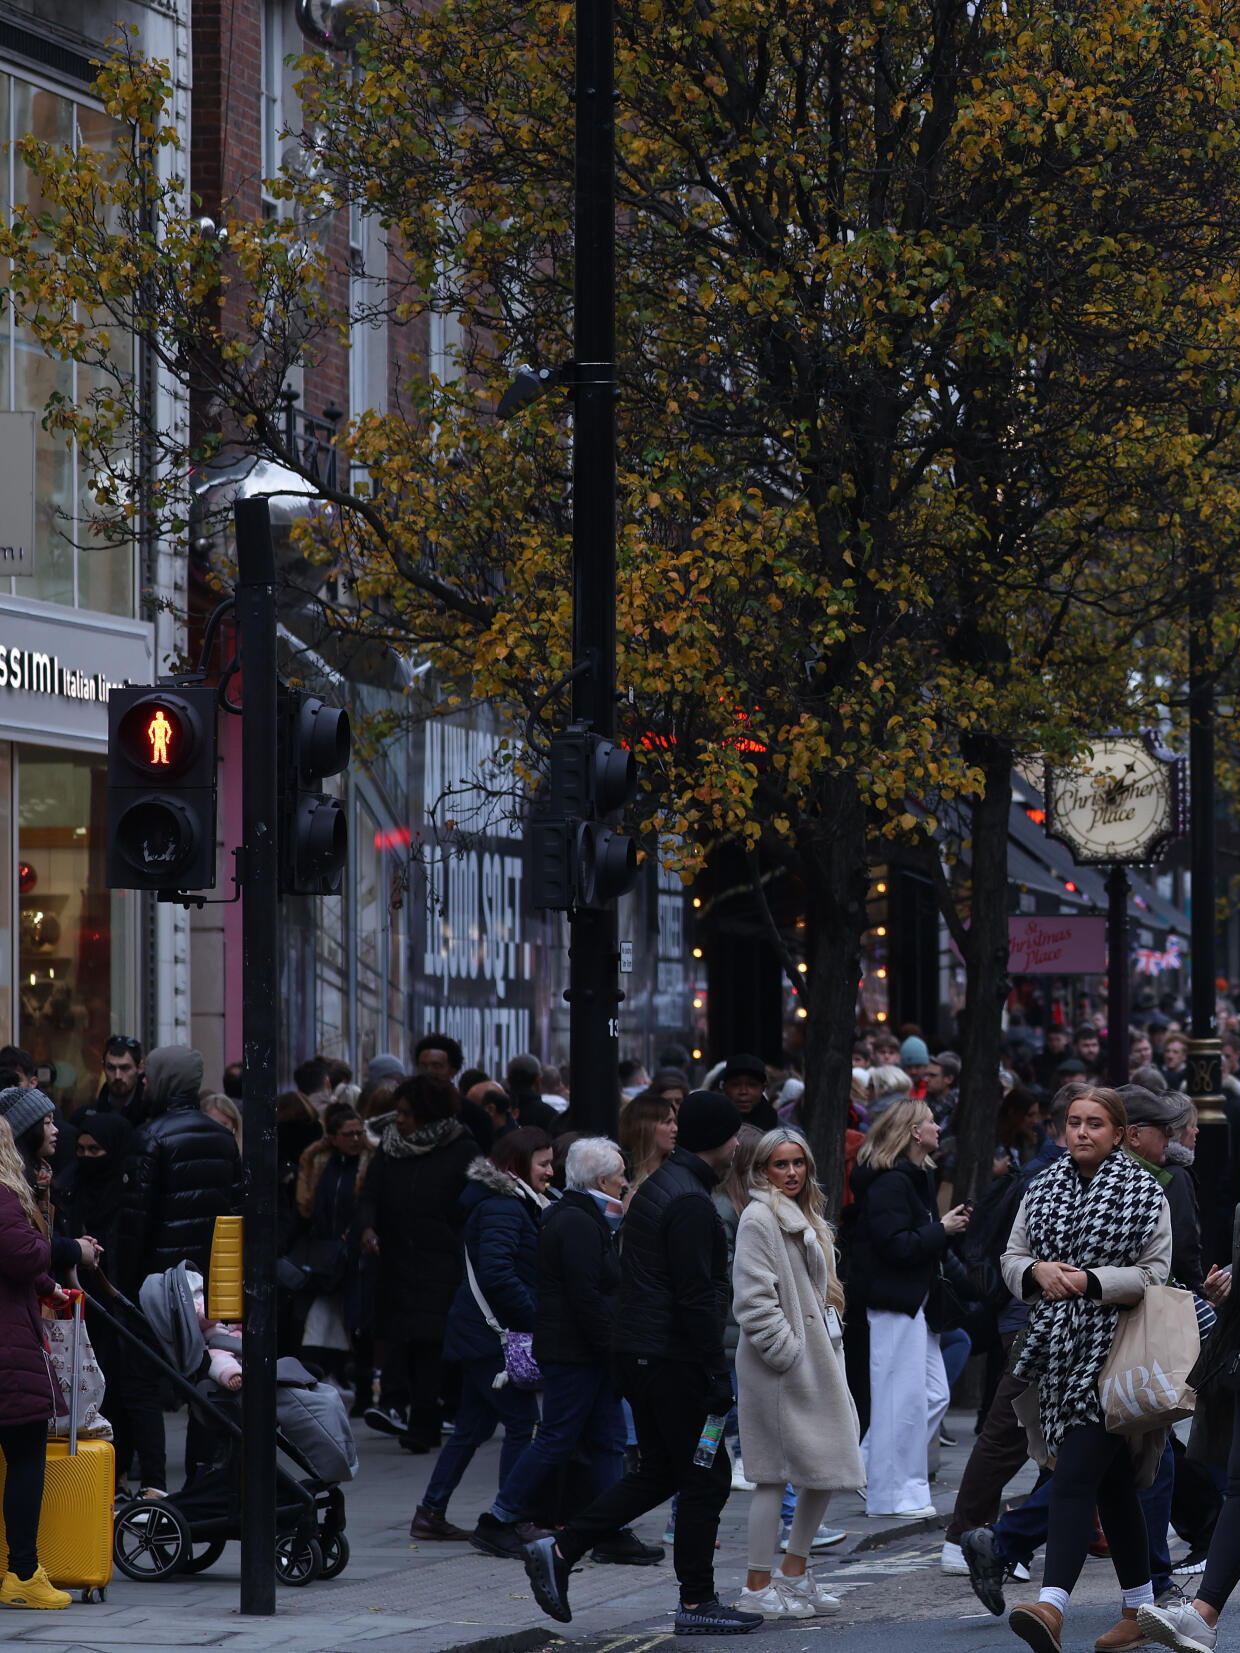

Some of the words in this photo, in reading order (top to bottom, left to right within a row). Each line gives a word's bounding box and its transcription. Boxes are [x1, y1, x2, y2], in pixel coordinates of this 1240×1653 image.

[63, 667, 96, 701] Italian
[1086, 803, 1136, 833] Place
[1008, 928, 1073, 955] hristmas
[1101, 1359, 1178, 1424] ZARA
